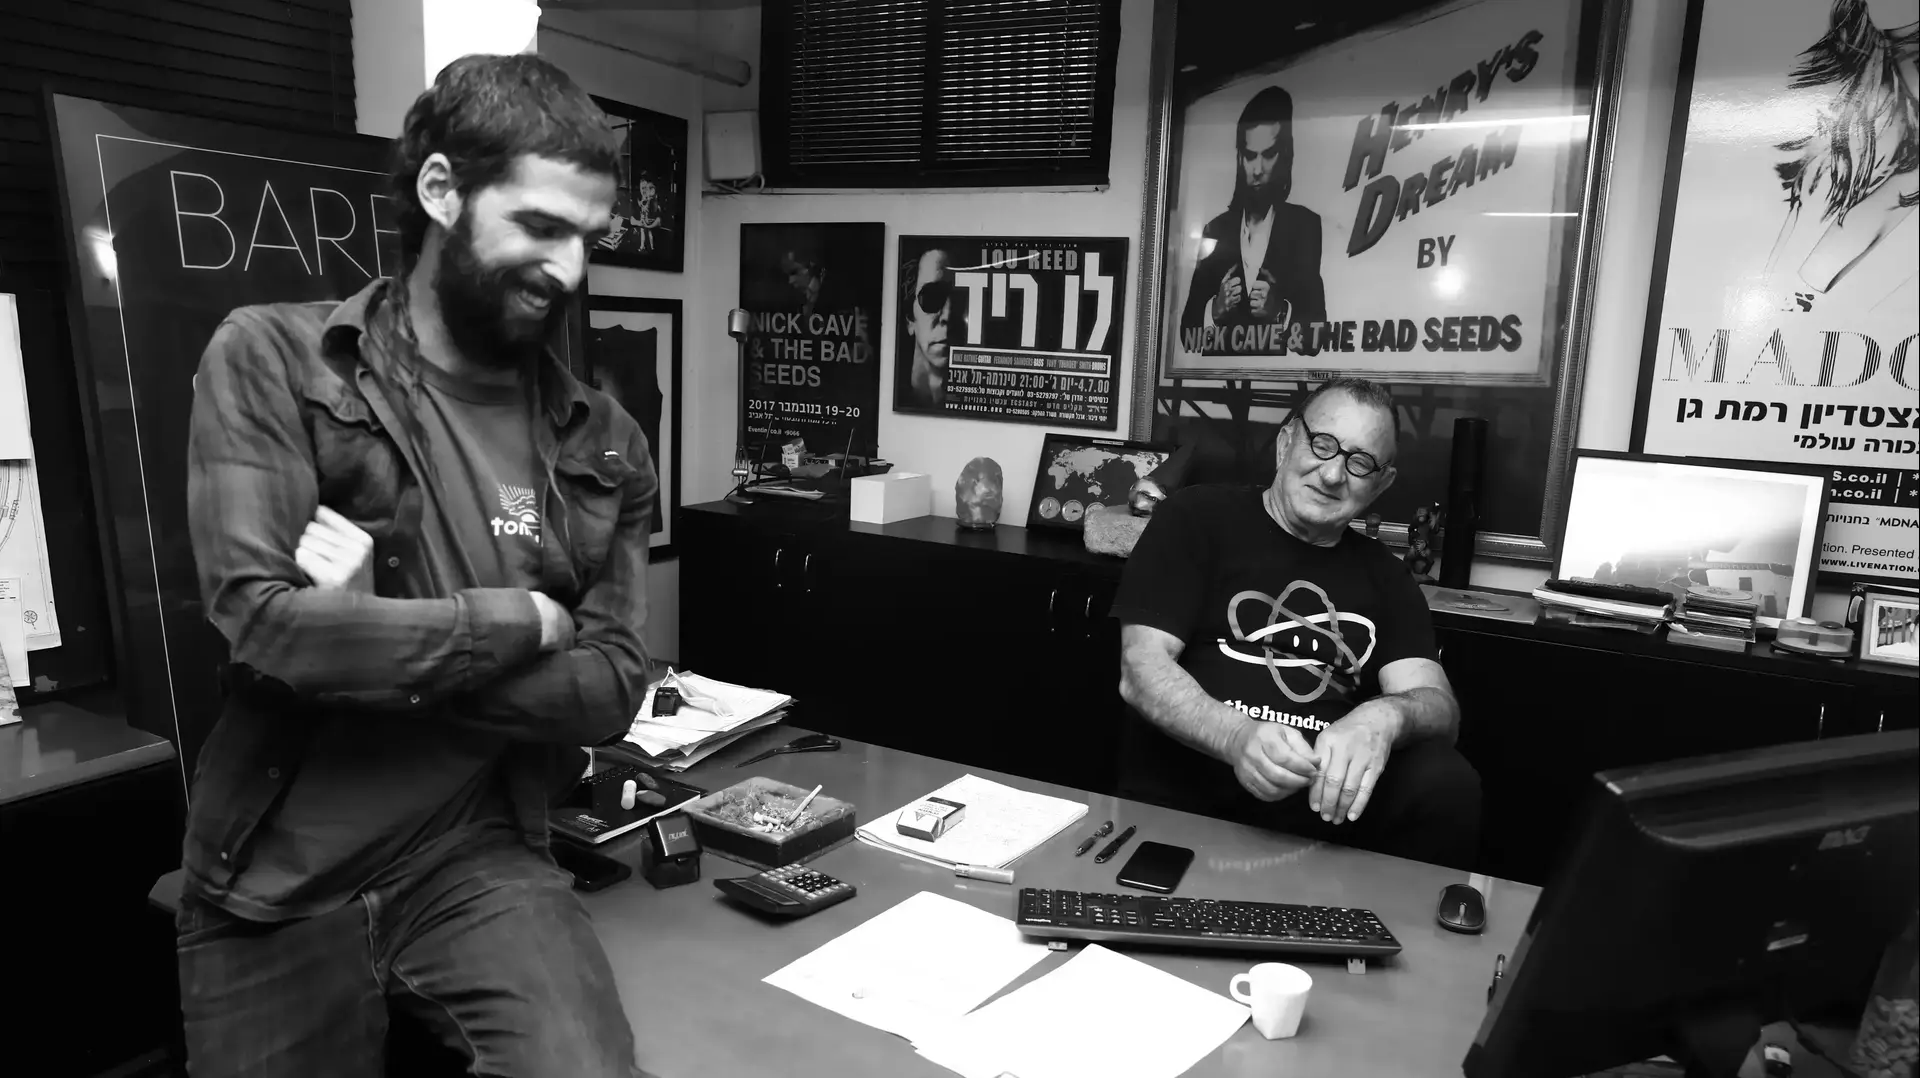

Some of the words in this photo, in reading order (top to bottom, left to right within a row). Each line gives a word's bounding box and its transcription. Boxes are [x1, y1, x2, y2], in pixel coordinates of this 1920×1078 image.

[1342, 29, 1544, 192] HENRY'S
[1346, 124, 1523, 258] DREAM
[982, 248, 1018, 269] LOU
[1028, 249, 1078, 271] REED
[1417, 234, 1456, 269] BY
[954, 272, 1039, 347] ריד
[1061, 252, 1114, 351] לו
[751, 312, 801, 334] NICK
[809, 306, 868, 336] CAVE
[1184, 325, 1228, 353] NICK
[1231, 324, 1284, 351] CAVE
[1287, 322, 1304, 350] &
[1310, 321, 1357, 352] THE
[1361, 319, 1418, 352] BAD
[1422, 314, 1522, 352] SEEDS
[751, 338, 764, 358] &
[770, 338, 813, 360] THE
[820, 340, 868, 364] BAD
[750, 362, 821, 387] SEEDS
[948, 369, 968, 384] אביב
[748, 399, 775, 411] 2017
[778, 401, 821, 415] בנובמבר
[825, 405, 860, 417] 19-20
[1010, 398, 1038, 408] ECSTASY
[1676, 398, 1703, 423] גן
[1715, 400, 1788, 422] רמת
[748, 411, 764, 419] אביב
[765, 412, 774, 420] תל
[1794, 433, 1856, 450] עולמי
[1863, 438, 1919, 455] כורה
[1826, 514, 1870, 525] בחנויות
[1852, 545, 1915, 559] Presented
[1821, 558, 1919, 572] WWW.LIVENATION.
